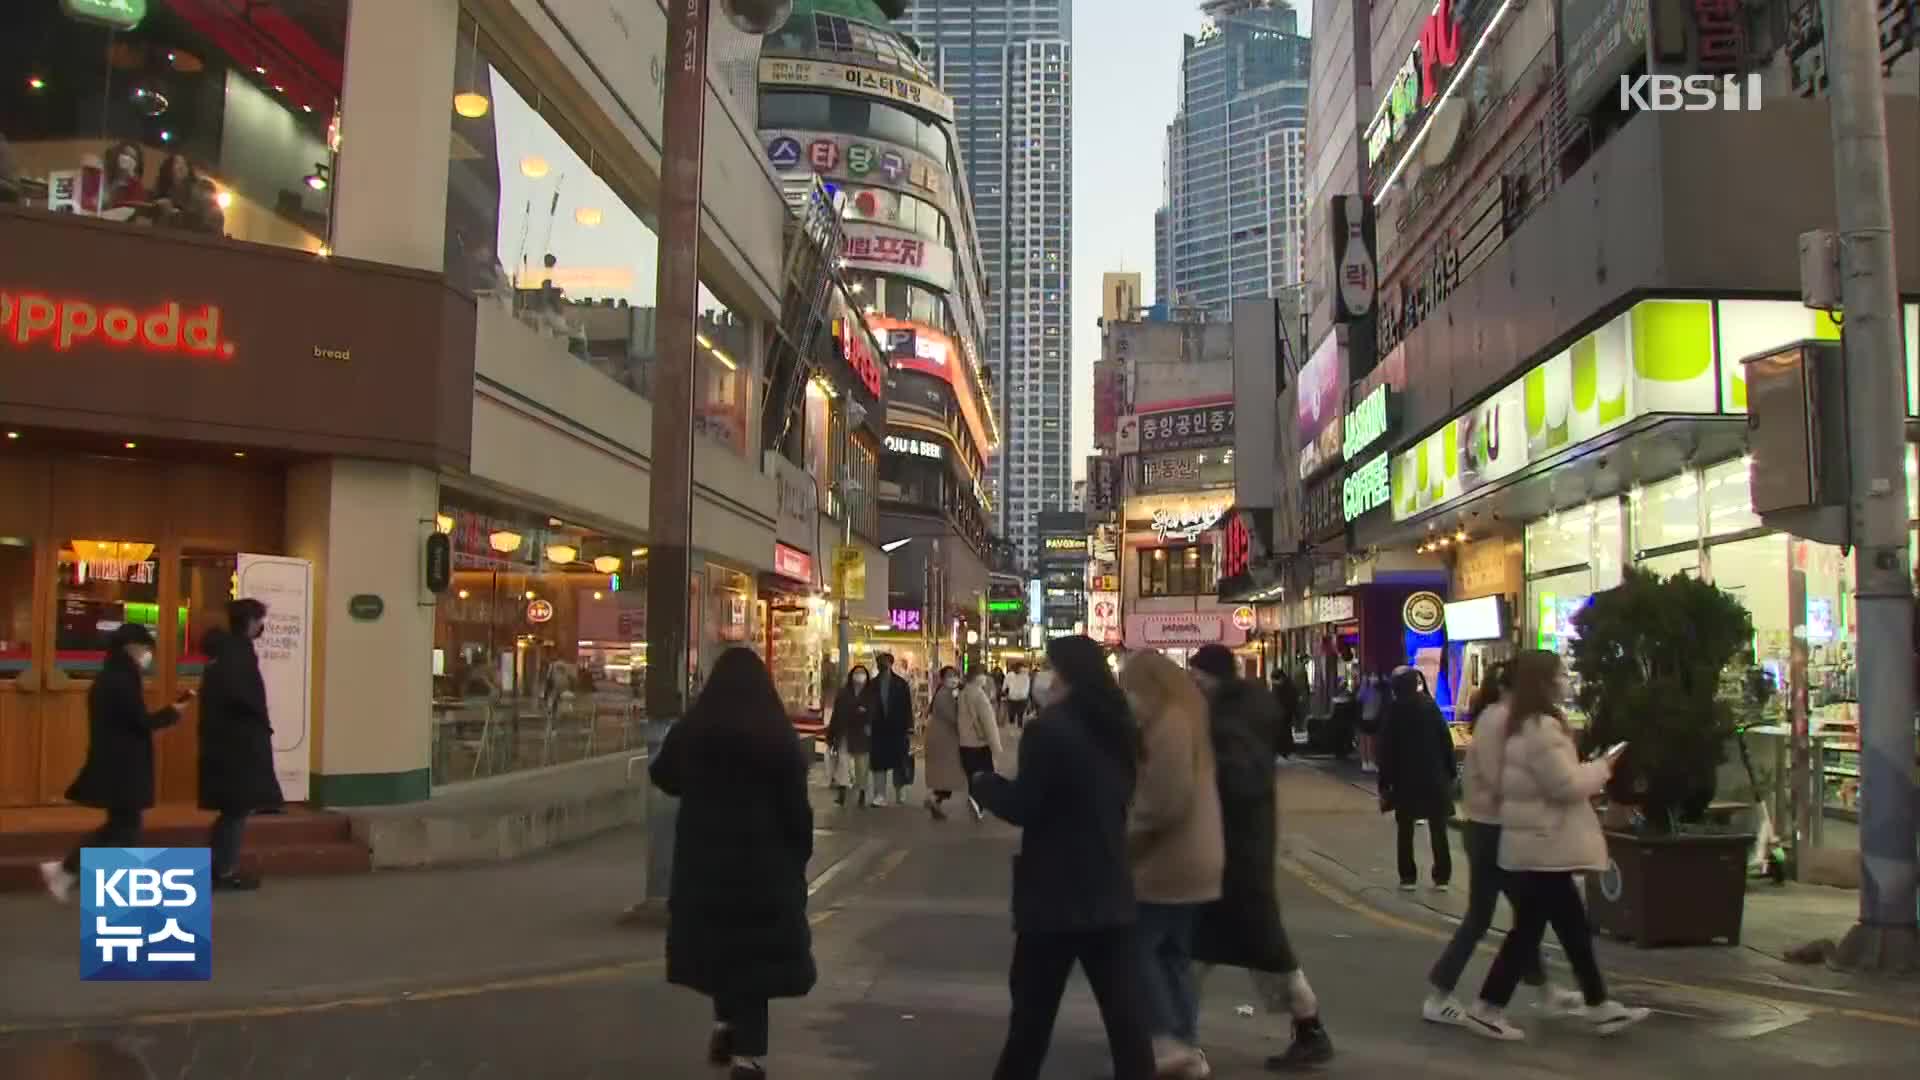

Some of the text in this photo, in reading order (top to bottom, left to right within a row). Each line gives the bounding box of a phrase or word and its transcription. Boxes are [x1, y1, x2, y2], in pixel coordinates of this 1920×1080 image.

[313, 345, 351, 361] bread
[1143, 411, 1236, 440] 중앙공인중
[1343, 451, 1390, 522] COFFEE
